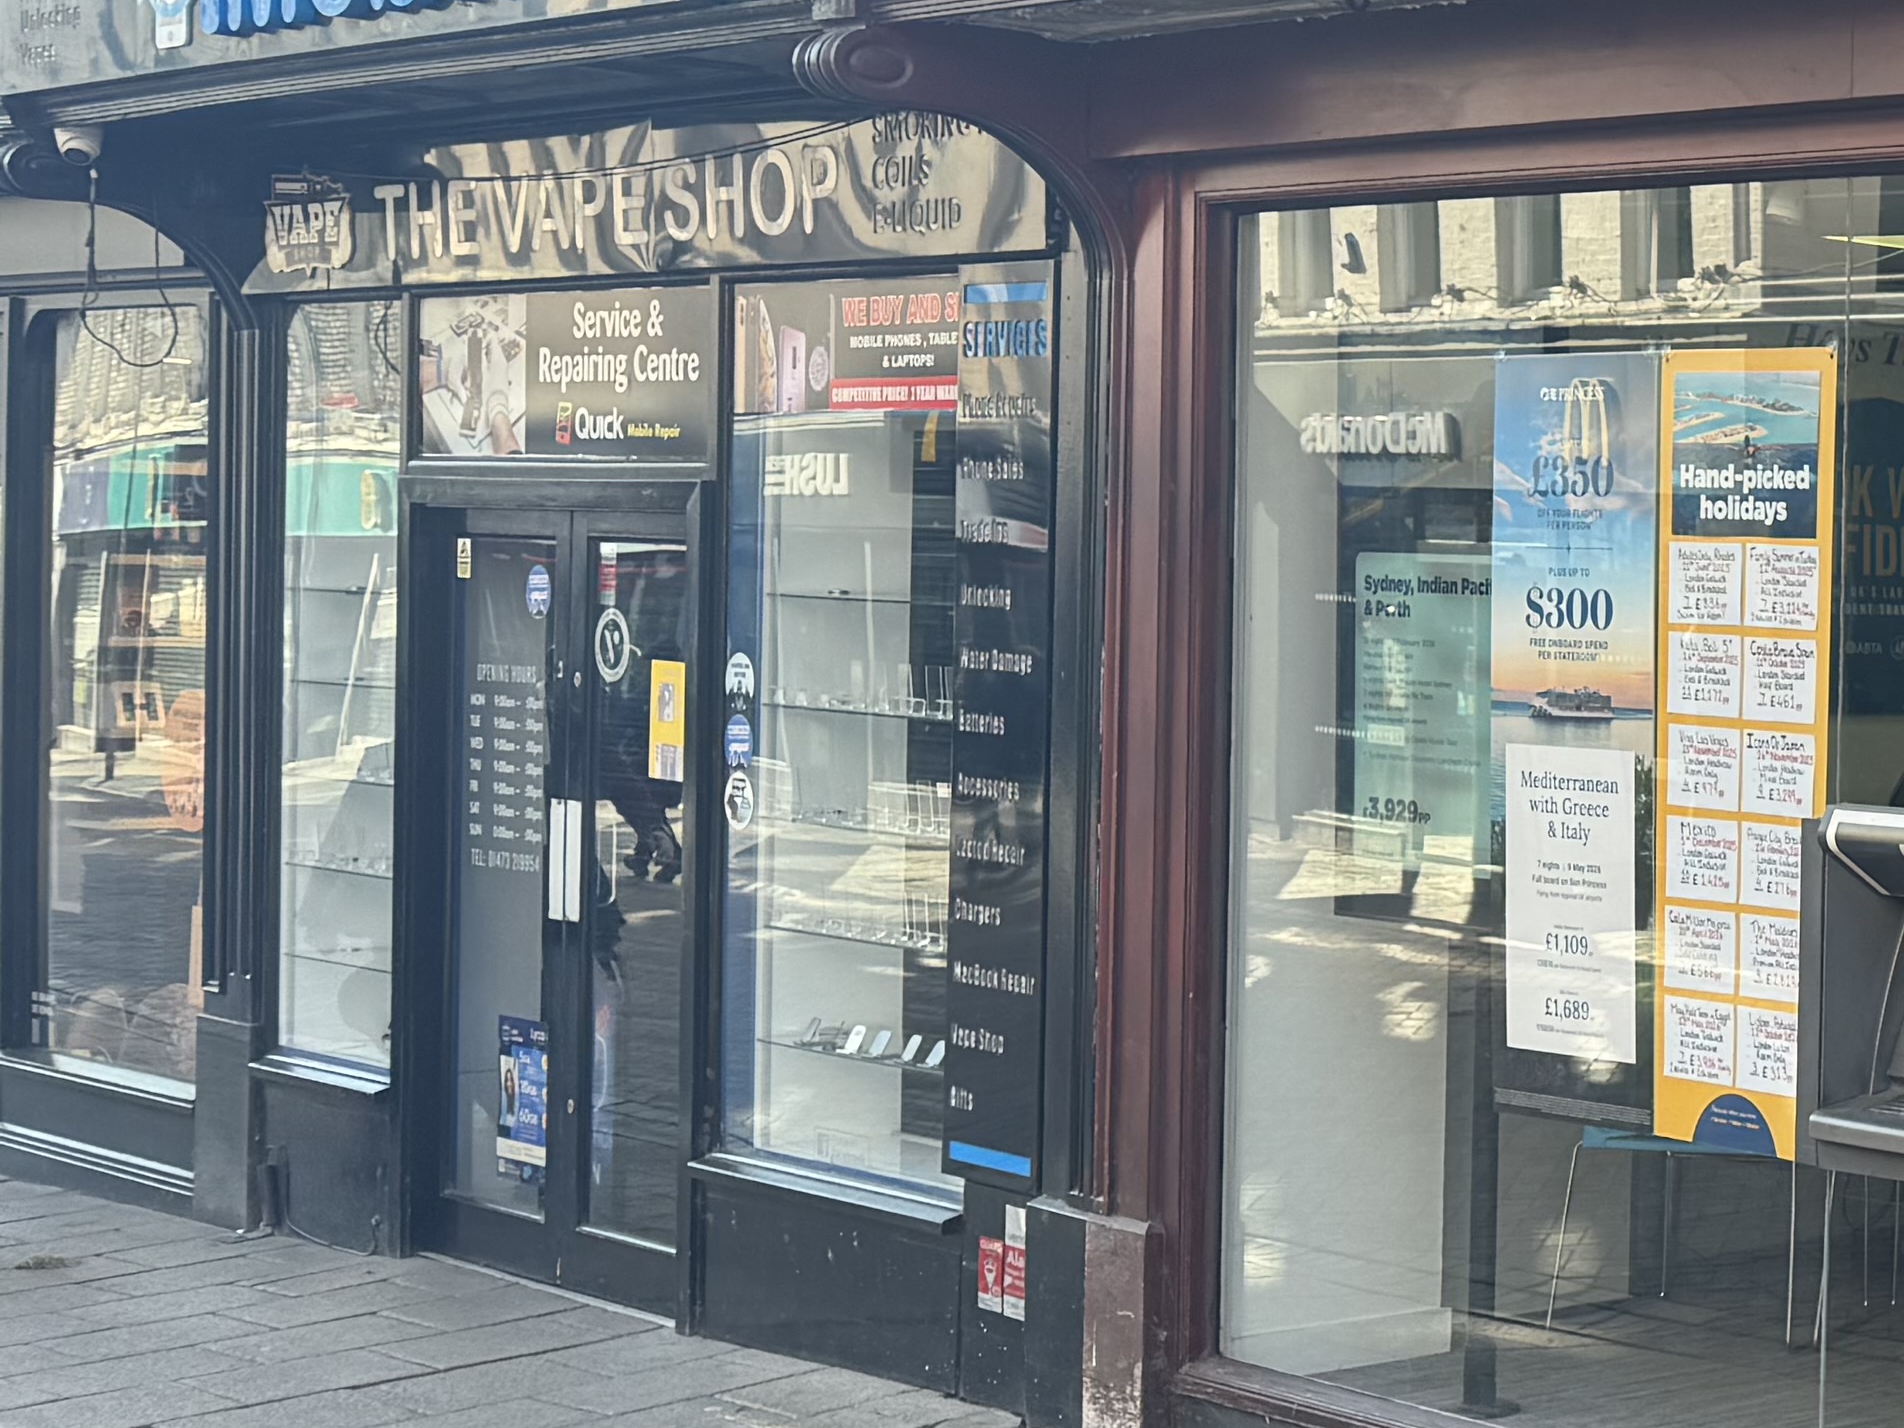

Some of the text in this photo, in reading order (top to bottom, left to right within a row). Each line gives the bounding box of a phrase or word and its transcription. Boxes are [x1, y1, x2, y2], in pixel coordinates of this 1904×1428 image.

[873, 153, 930, 190] COILS
[374, 143, 839, 262] THE VAPE SHOP
[873, 196, 962, 234] E-LIQUID
[271, 200, 341, 246] VAPE
[573, 299, 664, 340] Service &
[842, 293, 942, 327] WE BUY AND
[850, 335, 882, 349] MOBILE
[964, 318, 1047, 358] SERVICES
[538, 344, 700, 393] Repairing Centre
[892, 353, 934, 368] LAPTOPS!
[575, 409, 624, 442] Quick
[655, 425, 681, 440] Repair
[1528, 454, 1614, 500] £350
[1679, 464, 1810, 493] Hand-picked
[1700, 495, 1788, 525] holidays
[1363, 573, 1458, 598] Sydney, Indian
[1524, 582, 1614, 633] $300
[1520, 770, 1619, 795] Mediterranean
[1529, 796, 1610, 818] with Greece
[1547, 822, 1590, 846] & Italy
